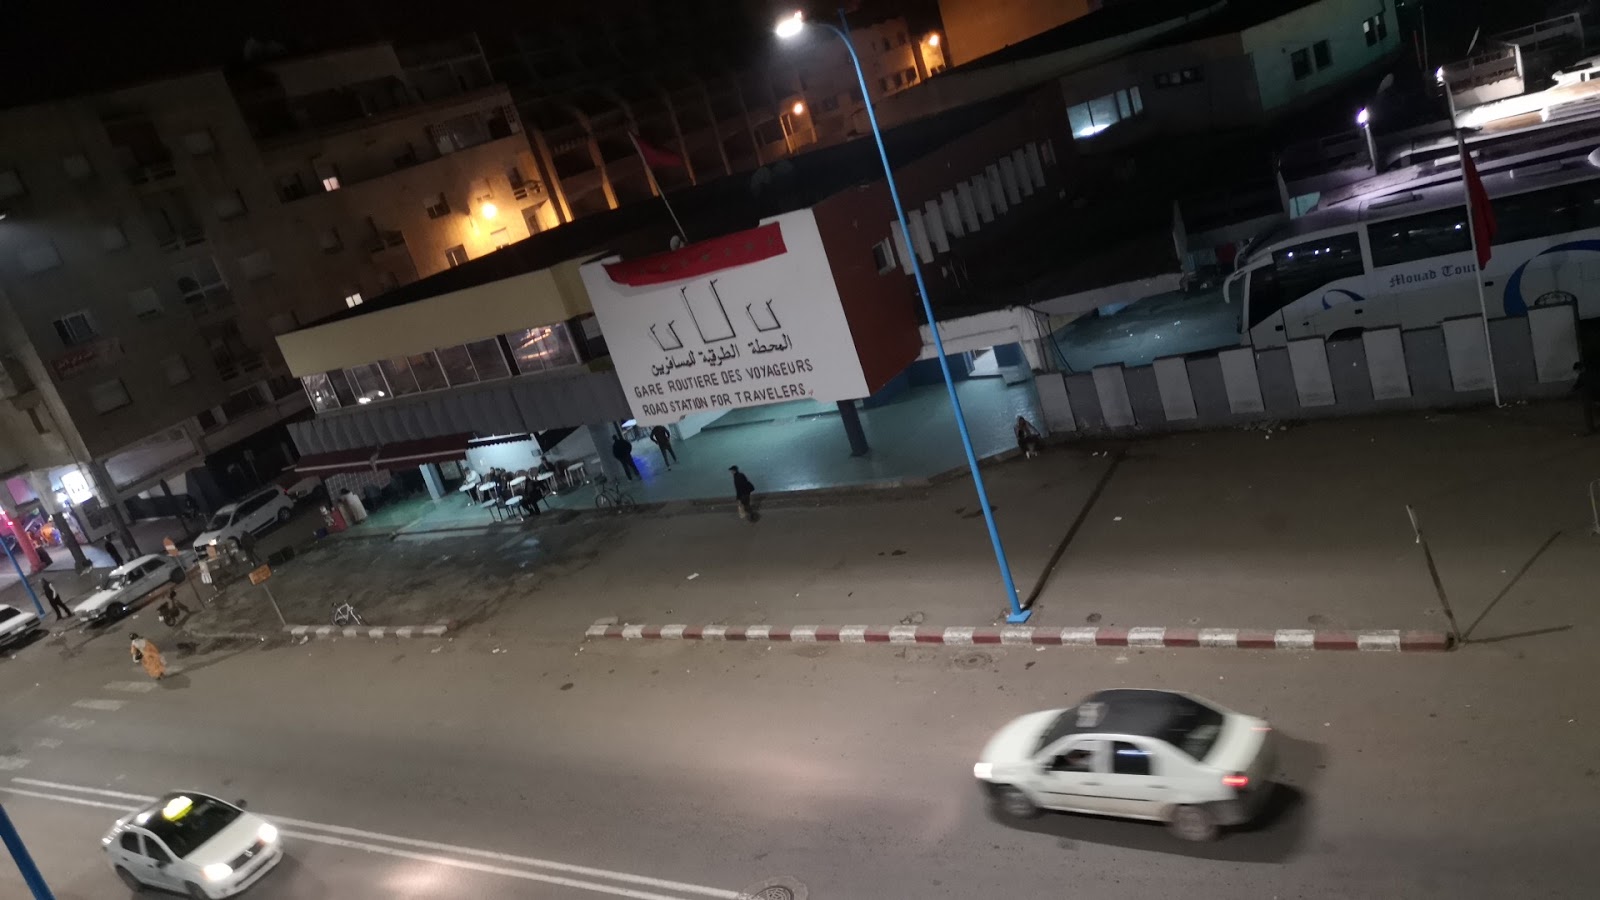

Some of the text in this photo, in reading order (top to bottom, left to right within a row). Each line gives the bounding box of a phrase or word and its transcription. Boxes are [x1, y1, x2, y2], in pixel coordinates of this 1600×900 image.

[651, 333, 792, 376] المحطة الطرقية للمسافرين
[634, 358, 813, 398] GARE ROUTIERE DES VOYAGEURS
[642, 383, 806, 416] ROAD STATION FOR TRAVELERS
